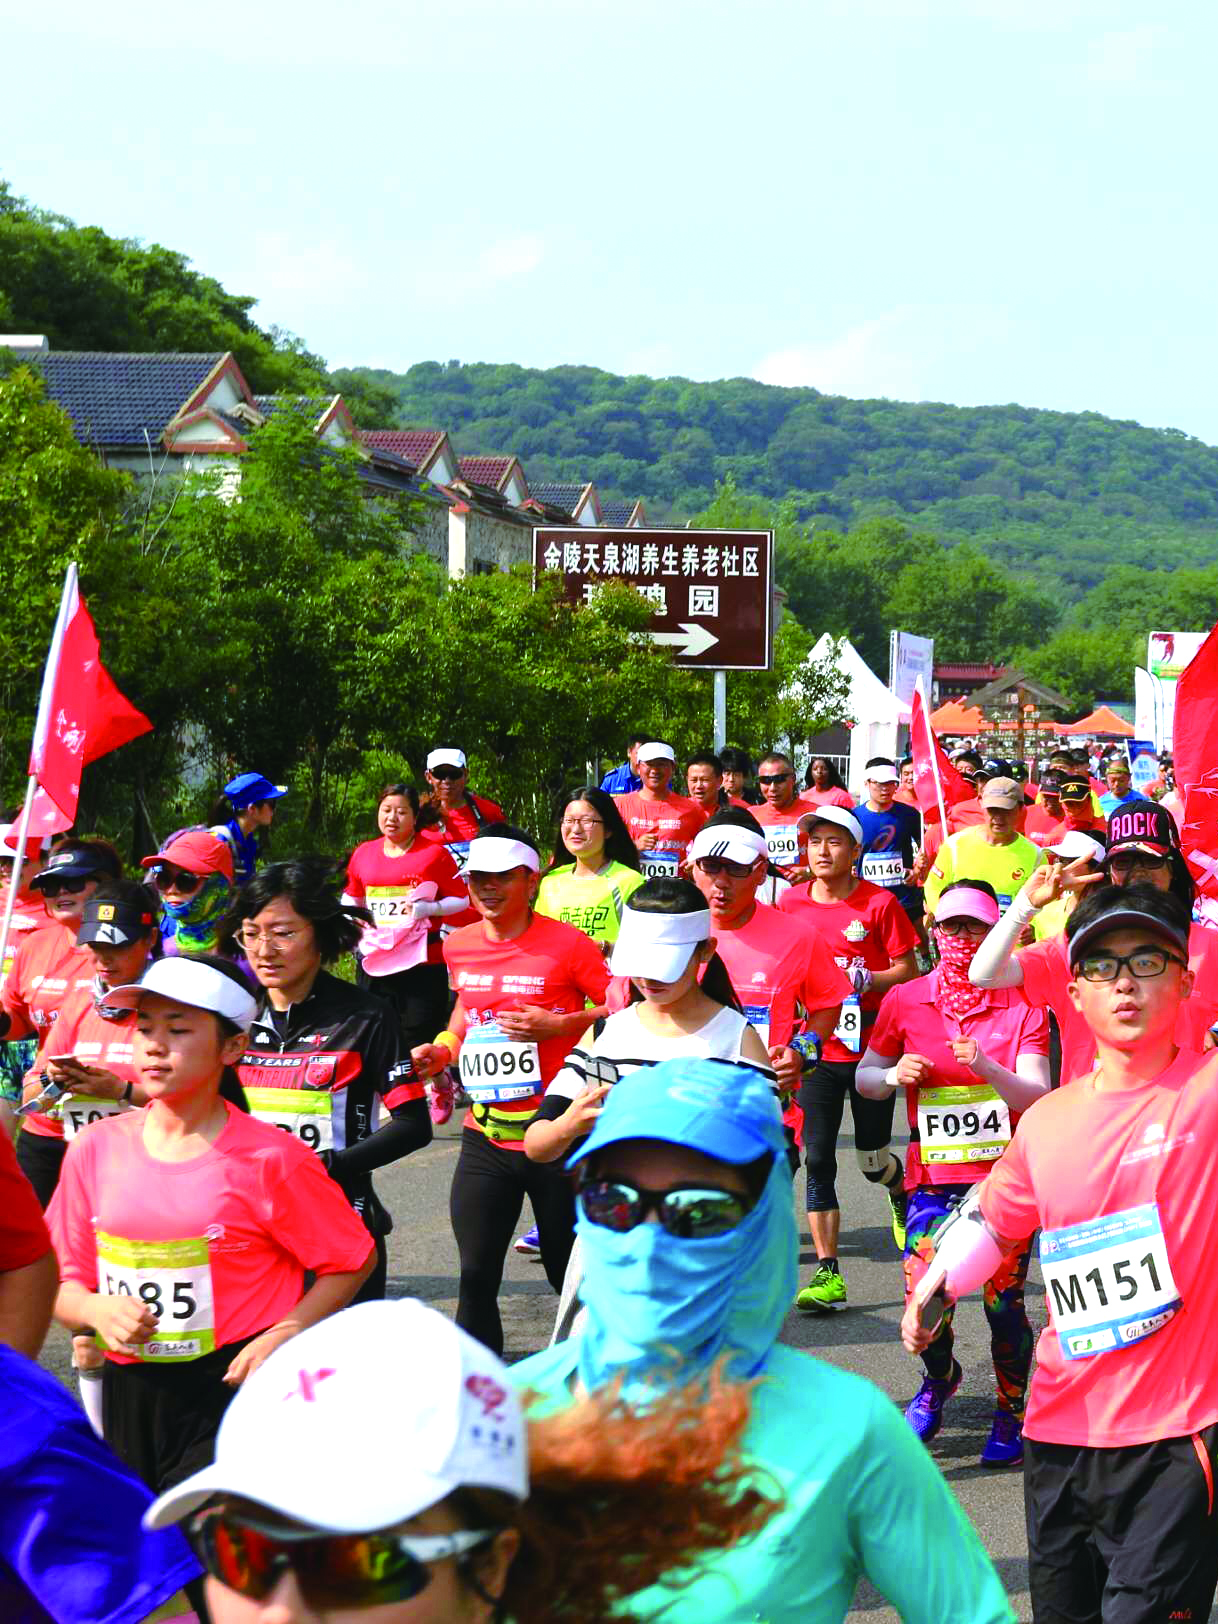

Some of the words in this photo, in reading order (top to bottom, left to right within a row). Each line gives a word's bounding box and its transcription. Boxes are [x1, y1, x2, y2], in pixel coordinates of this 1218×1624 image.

[543, 541, 760, 577] 金陵天泉湖养生养老社区
[1111, 812, 1158, 842] ROCK
[864, 863, 902, 876] M146
[257, 1058, 303, 1067] YEARS
[463, 1050, 535, 1077] M096
[926, 1109, 1001, 1137] F094
[1050, 1252, 1162, 1316] M151
